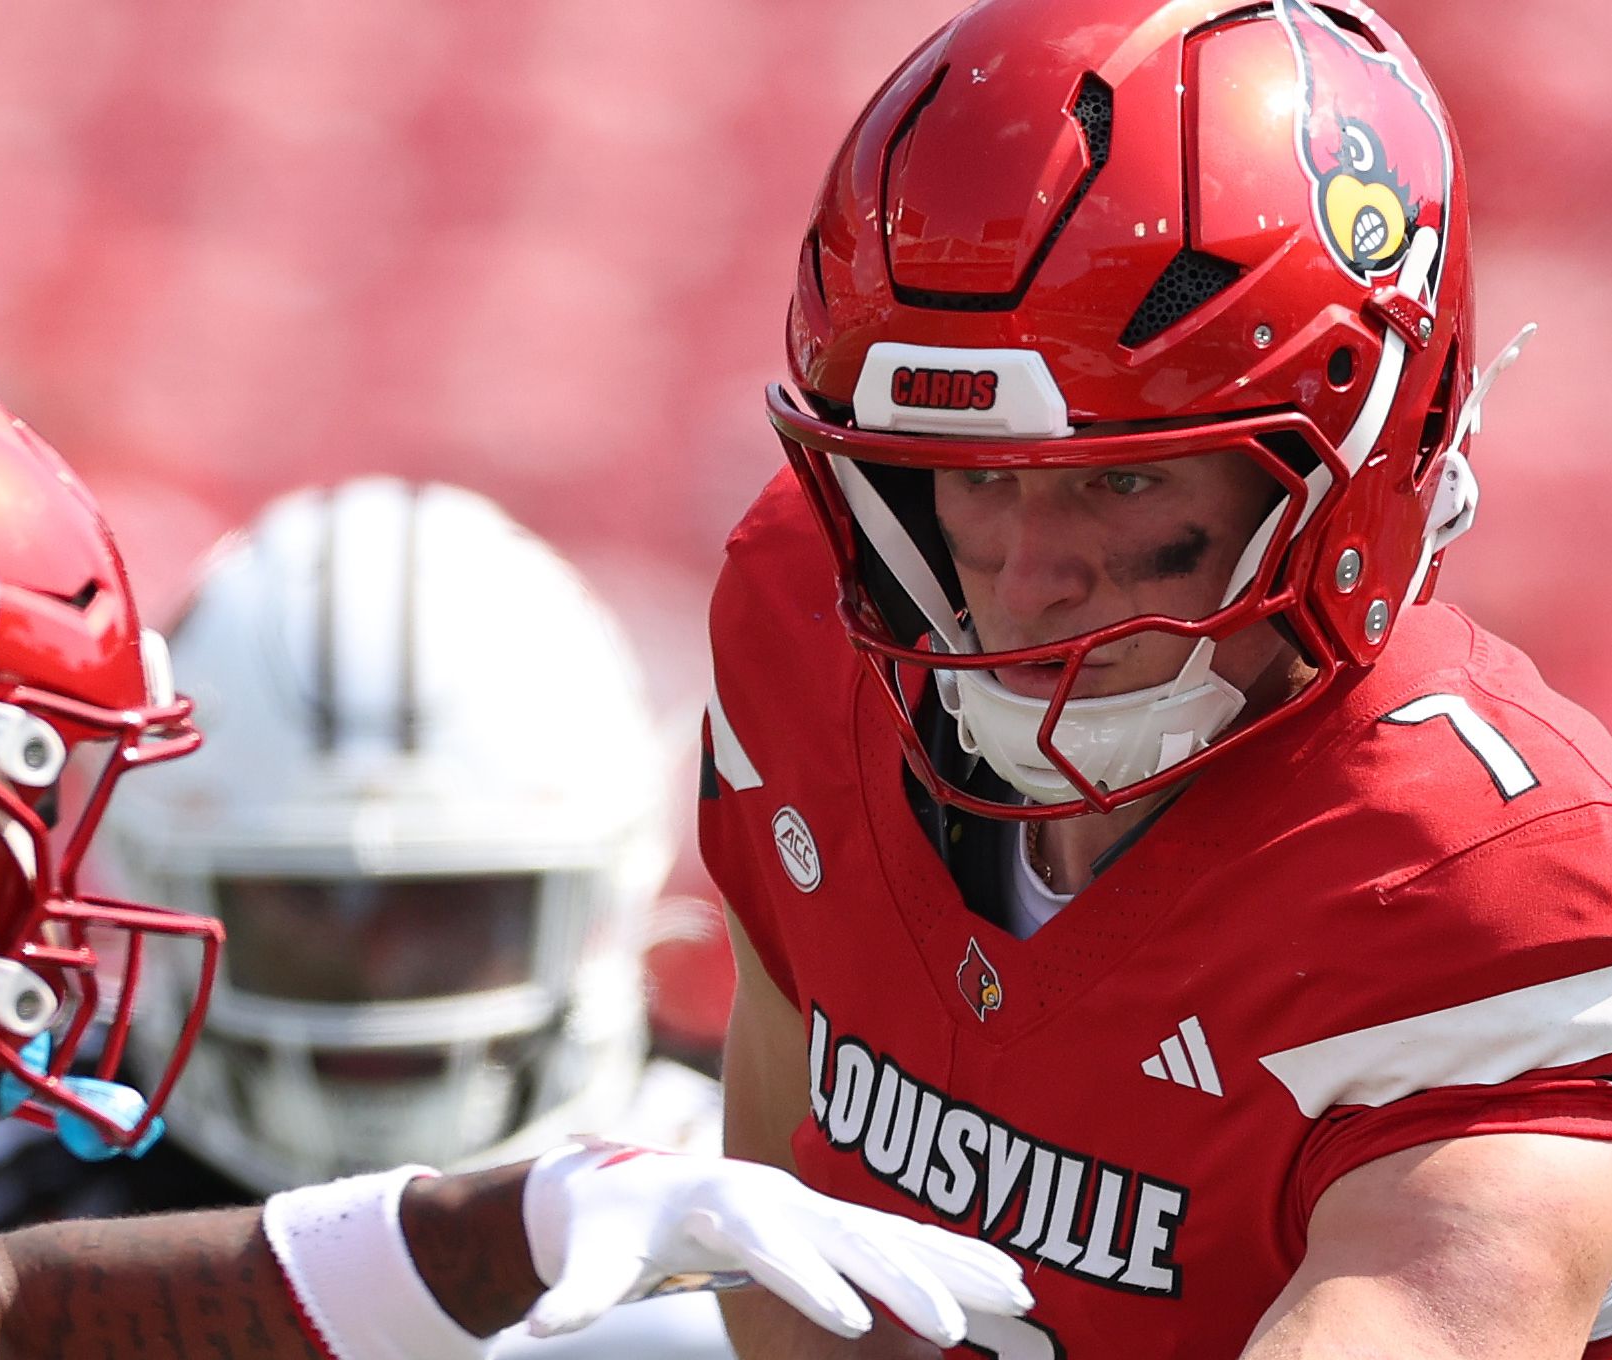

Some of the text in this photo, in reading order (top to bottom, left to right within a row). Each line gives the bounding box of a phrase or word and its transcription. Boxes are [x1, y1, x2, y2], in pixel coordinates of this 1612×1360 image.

[891, 366, 998, 410] CARDS
[1377, 692, 1542, 806] 7
[779, 827, 814, 870] ACC
[809, 1001, 1187, 1298] LOUISVILLE
